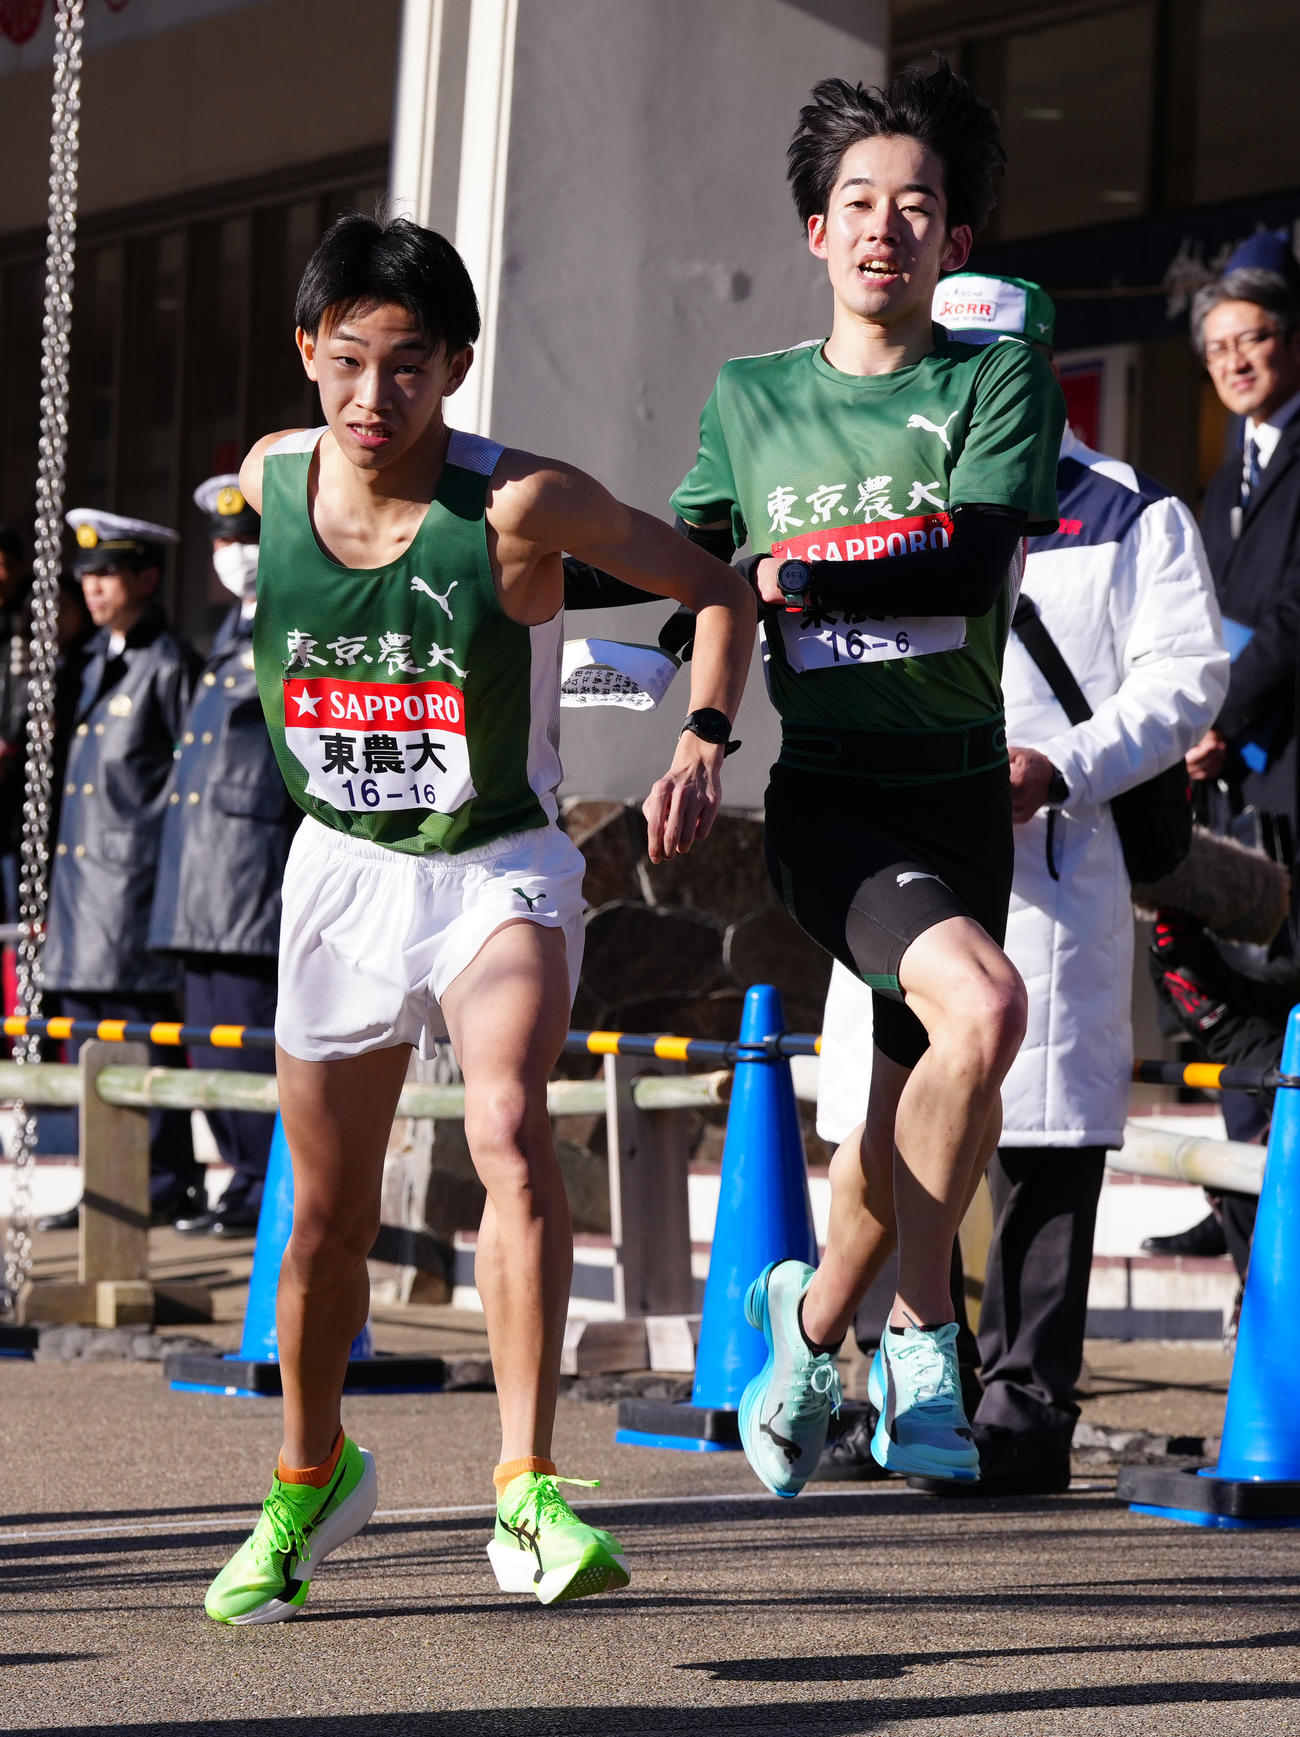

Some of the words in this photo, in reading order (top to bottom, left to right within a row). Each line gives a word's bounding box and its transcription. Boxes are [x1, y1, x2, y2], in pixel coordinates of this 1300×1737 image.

[767, 475, 950, 534] 東京農大
[286, 628, 470, 679] 東京農大
[330, 690, 460, 724] SAPPORO
[319, 732, 448, 775] 東農大
